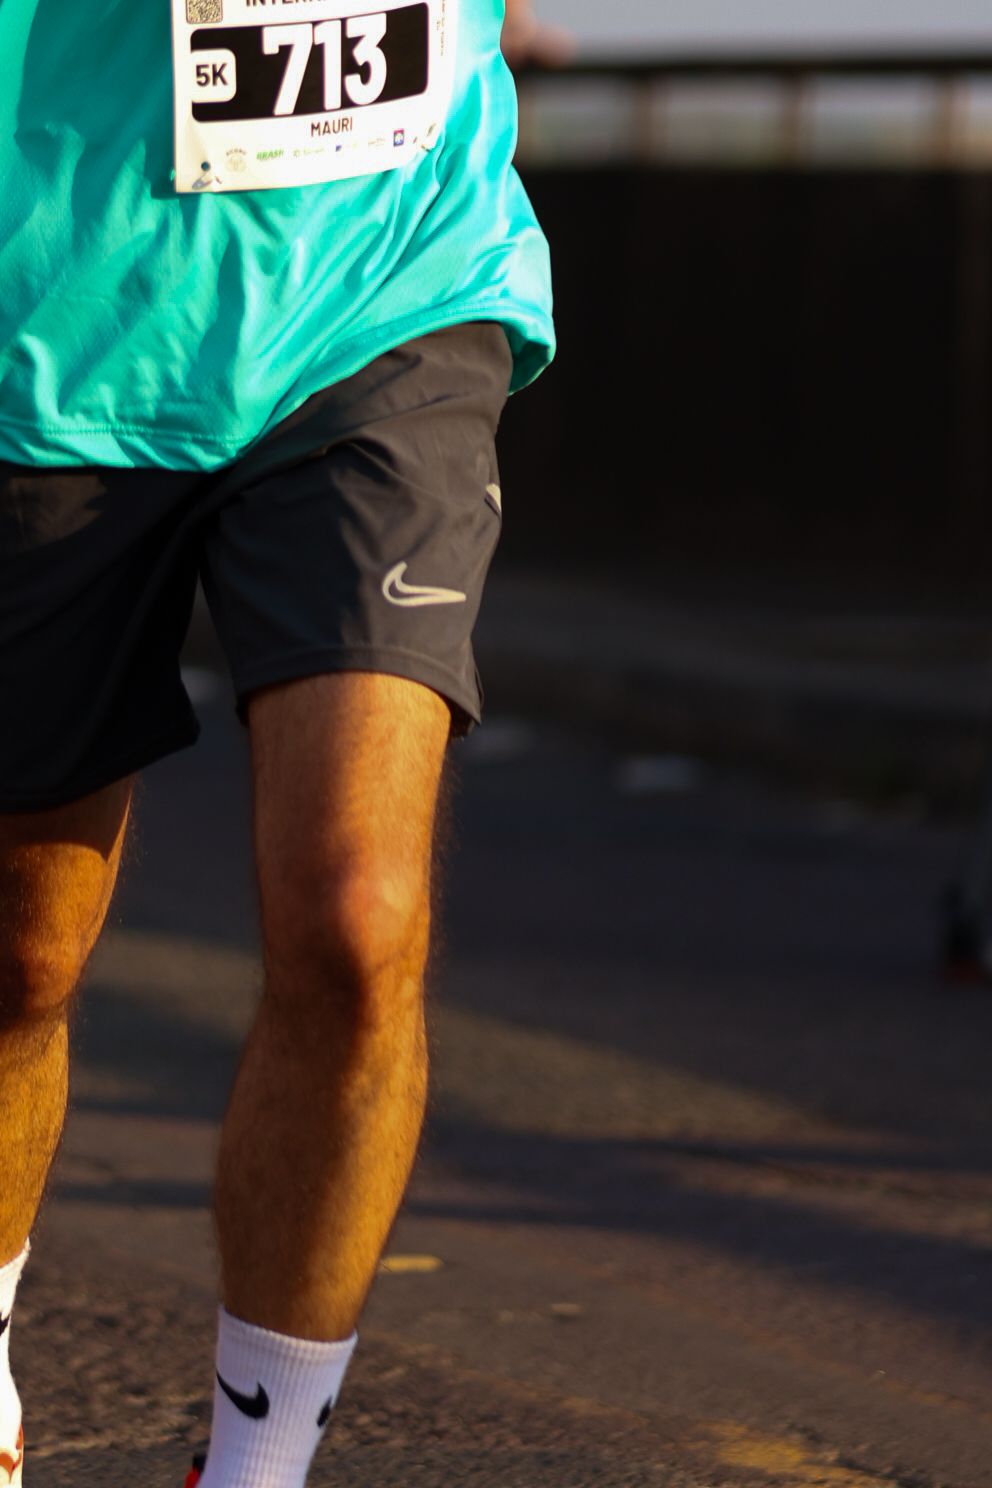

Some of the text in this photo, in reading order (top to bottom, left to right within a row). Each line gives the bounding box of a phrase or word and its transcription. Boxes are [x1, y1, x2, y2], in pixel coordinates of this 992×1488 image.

[195, 63, 229, 87] 5K
[262, 13, 388, 117] 713
[310, 116, 354, 138] MAURI
